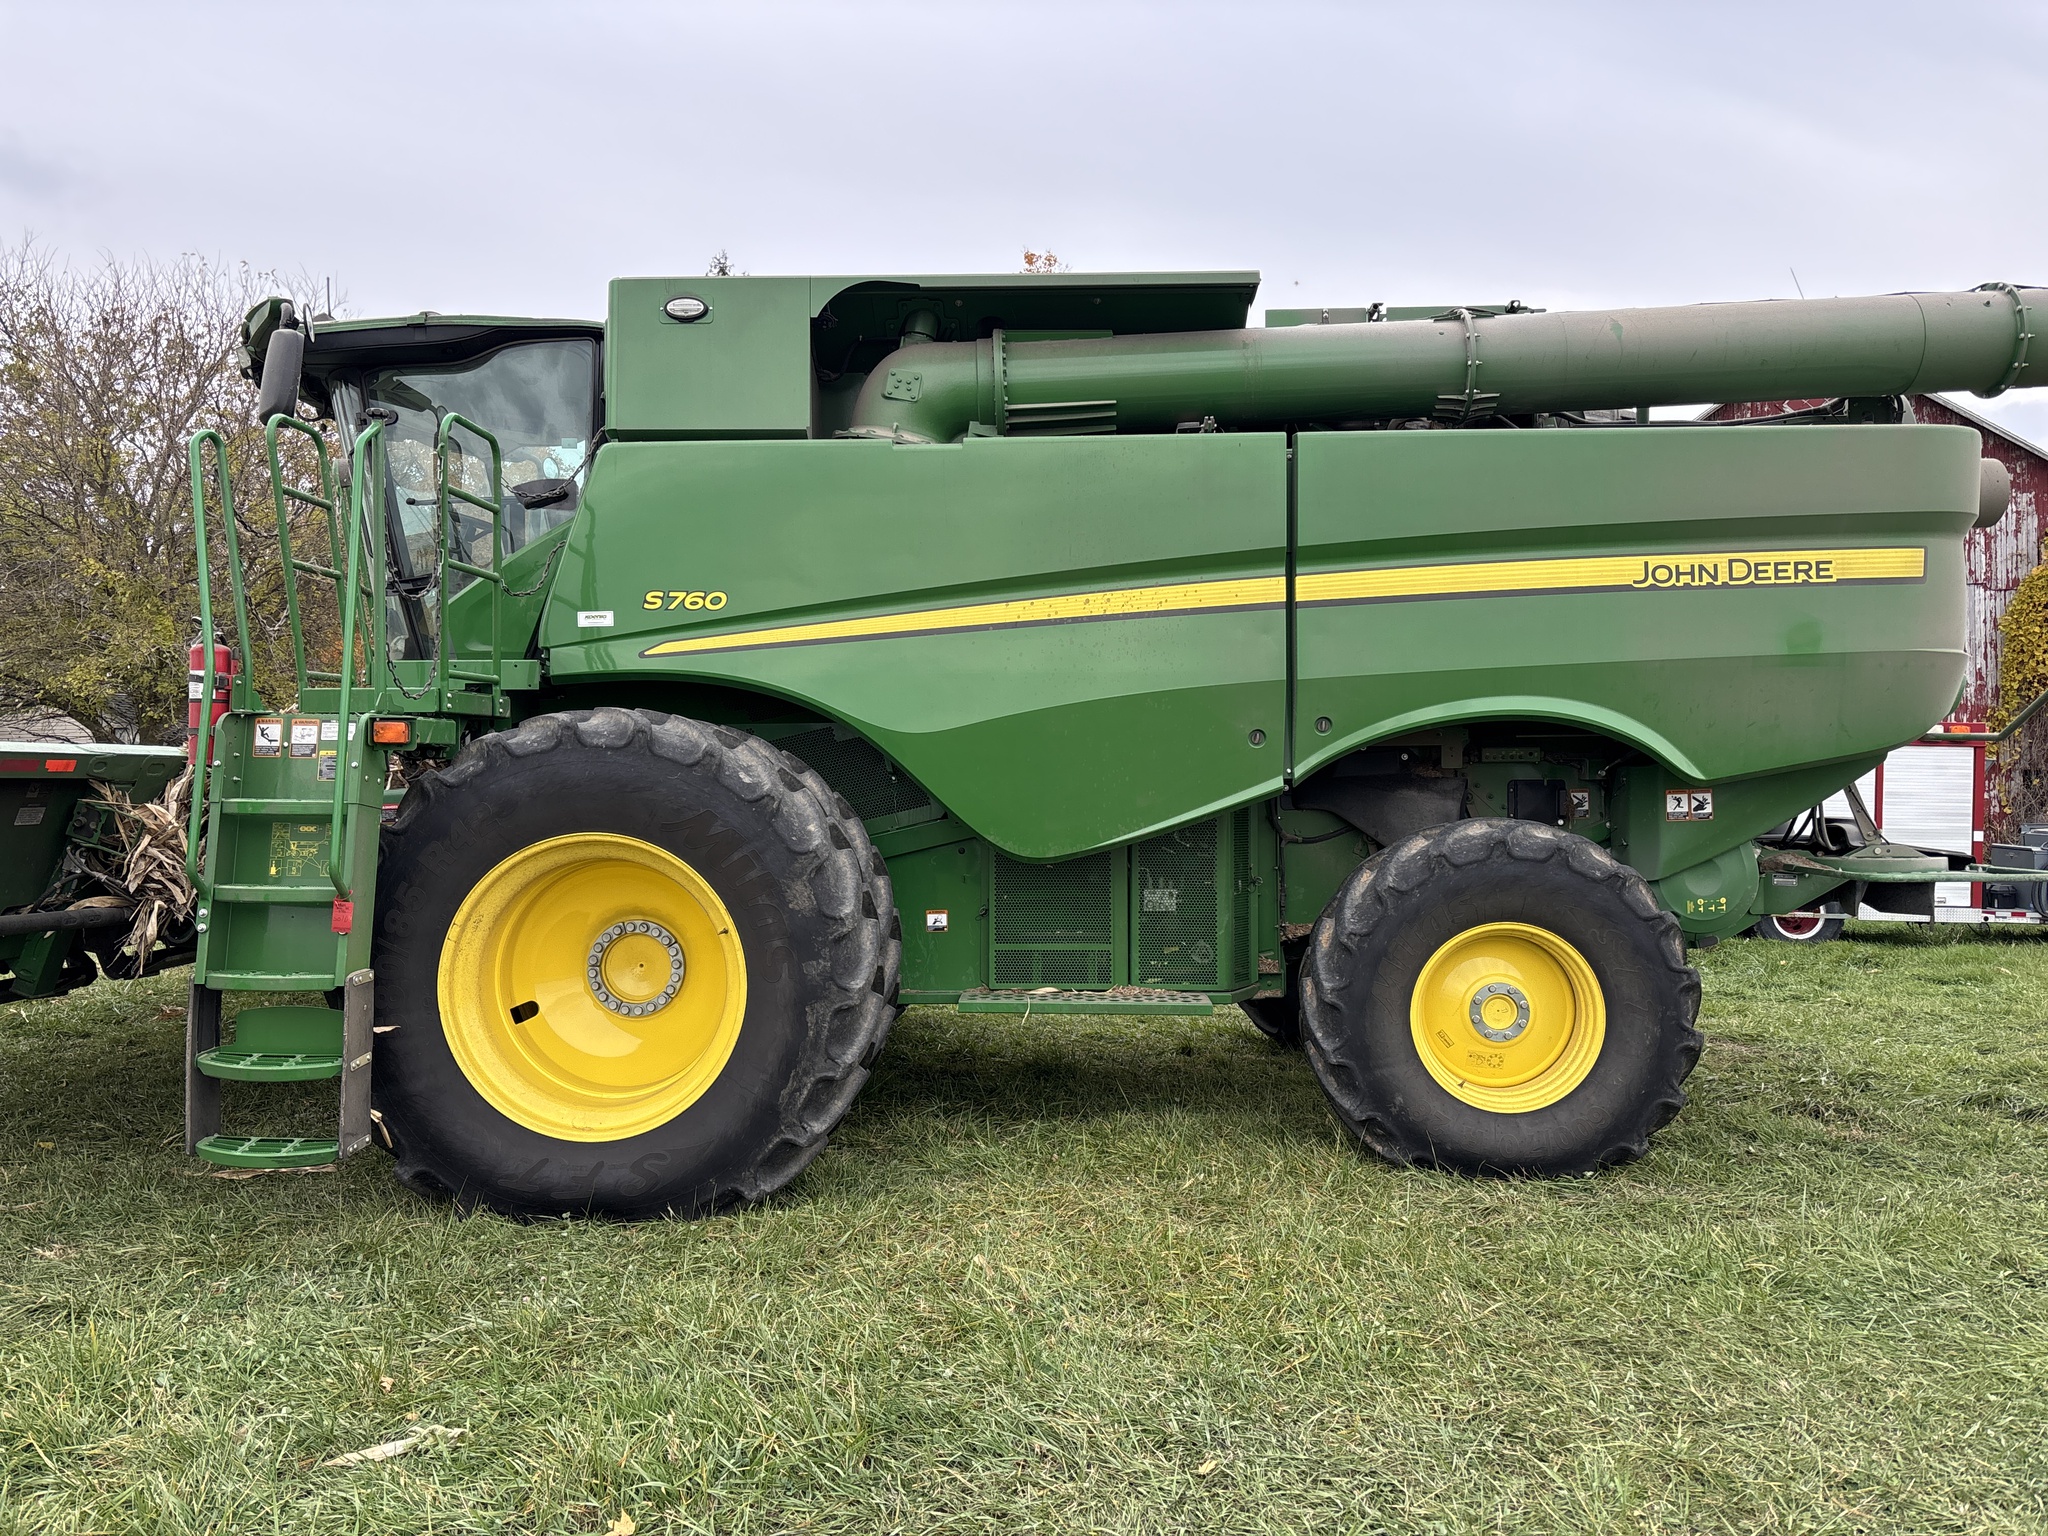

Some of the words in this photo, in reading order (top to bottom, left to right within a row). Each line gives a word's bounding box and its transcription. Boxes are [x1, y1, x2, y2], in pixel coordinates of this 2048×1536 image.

[1632, 560, 1719, 585] JOHN
[1727, 558, 1834, 582] DEERE
[642, 590, 729, 612] S760
